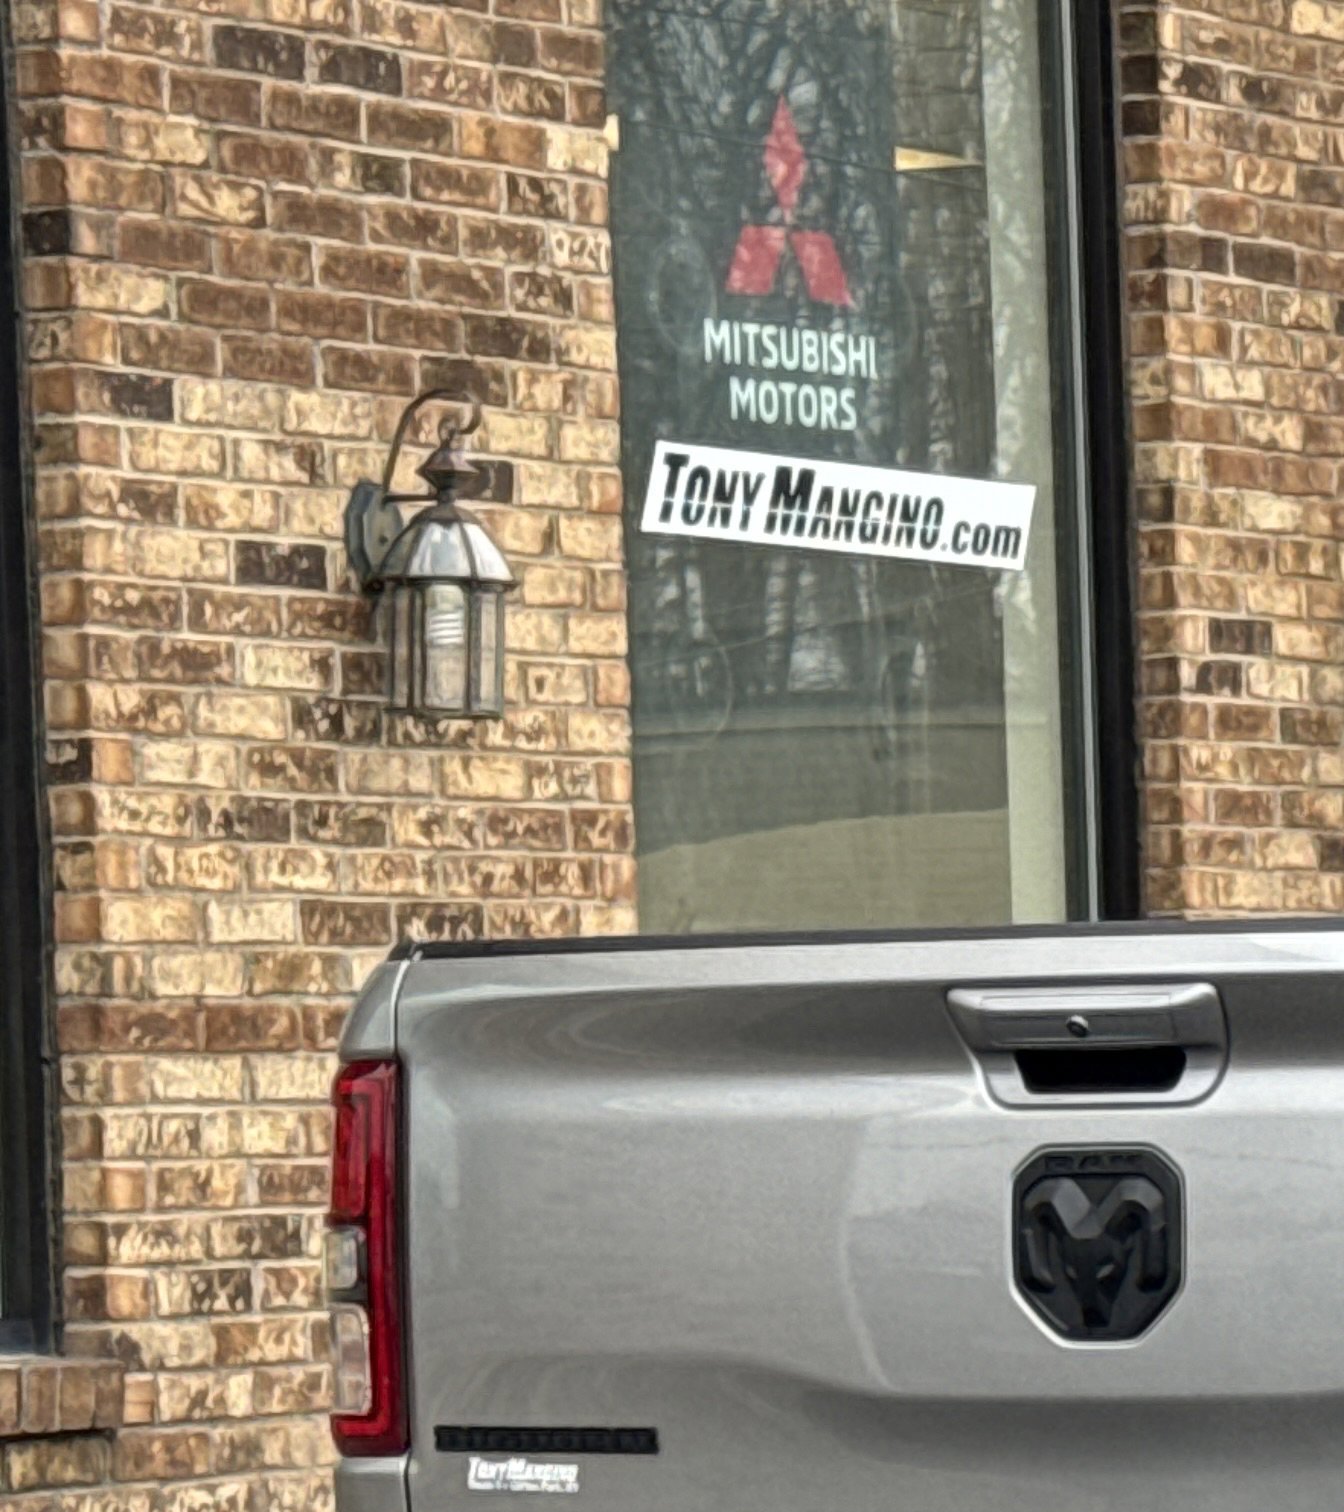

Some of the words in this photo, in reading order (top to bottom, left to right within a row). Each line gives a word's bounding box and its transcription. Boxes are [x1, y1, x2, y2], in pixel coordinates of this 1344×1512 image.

[703, 317, 878, 379] MITSUBISHI
[729, 375, 857, 431] MOTORS
[658, 452, 766, 532] TONY
